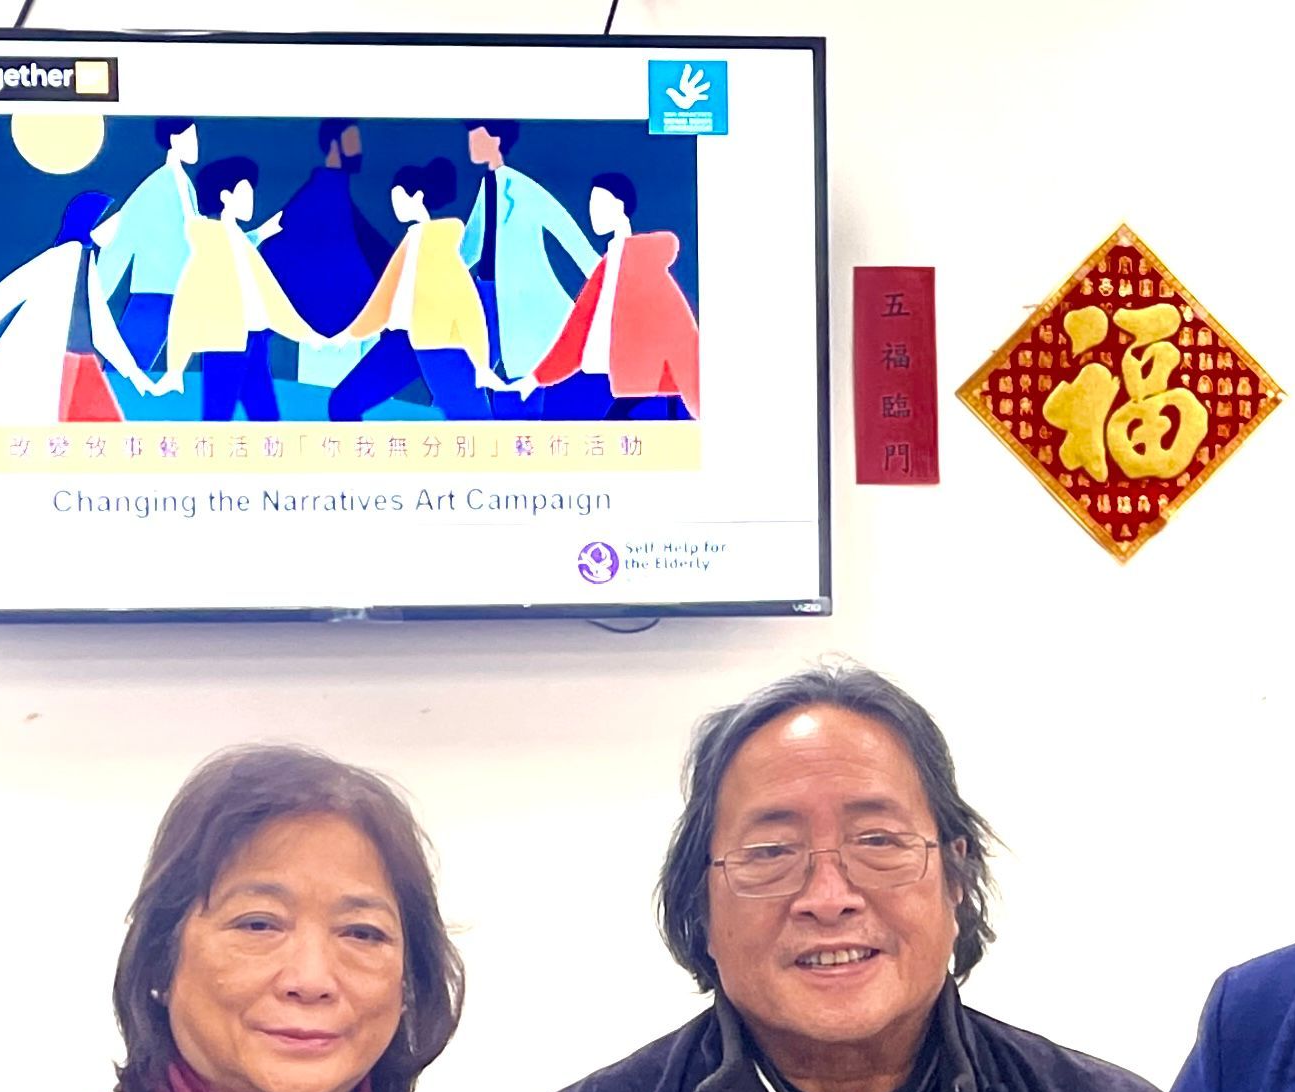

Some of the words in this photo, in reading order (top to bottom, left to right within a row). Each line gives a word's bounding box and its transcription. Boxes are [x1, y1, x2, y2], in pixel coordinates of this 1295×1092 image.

[880, 293, 912, 474] 五福臨門
[1042, 303, 1209, 483] 福
[53, 489, 197, 518] Changing
[209, 490, 250, 512] the
[262, 489, 404, 512] Narratives
[415, 489, 456, 511] Art
[466, 488, 612, 515] Campaign
[625, 557, 650, 570] the
[655, 557, 710, 571] Elderly
